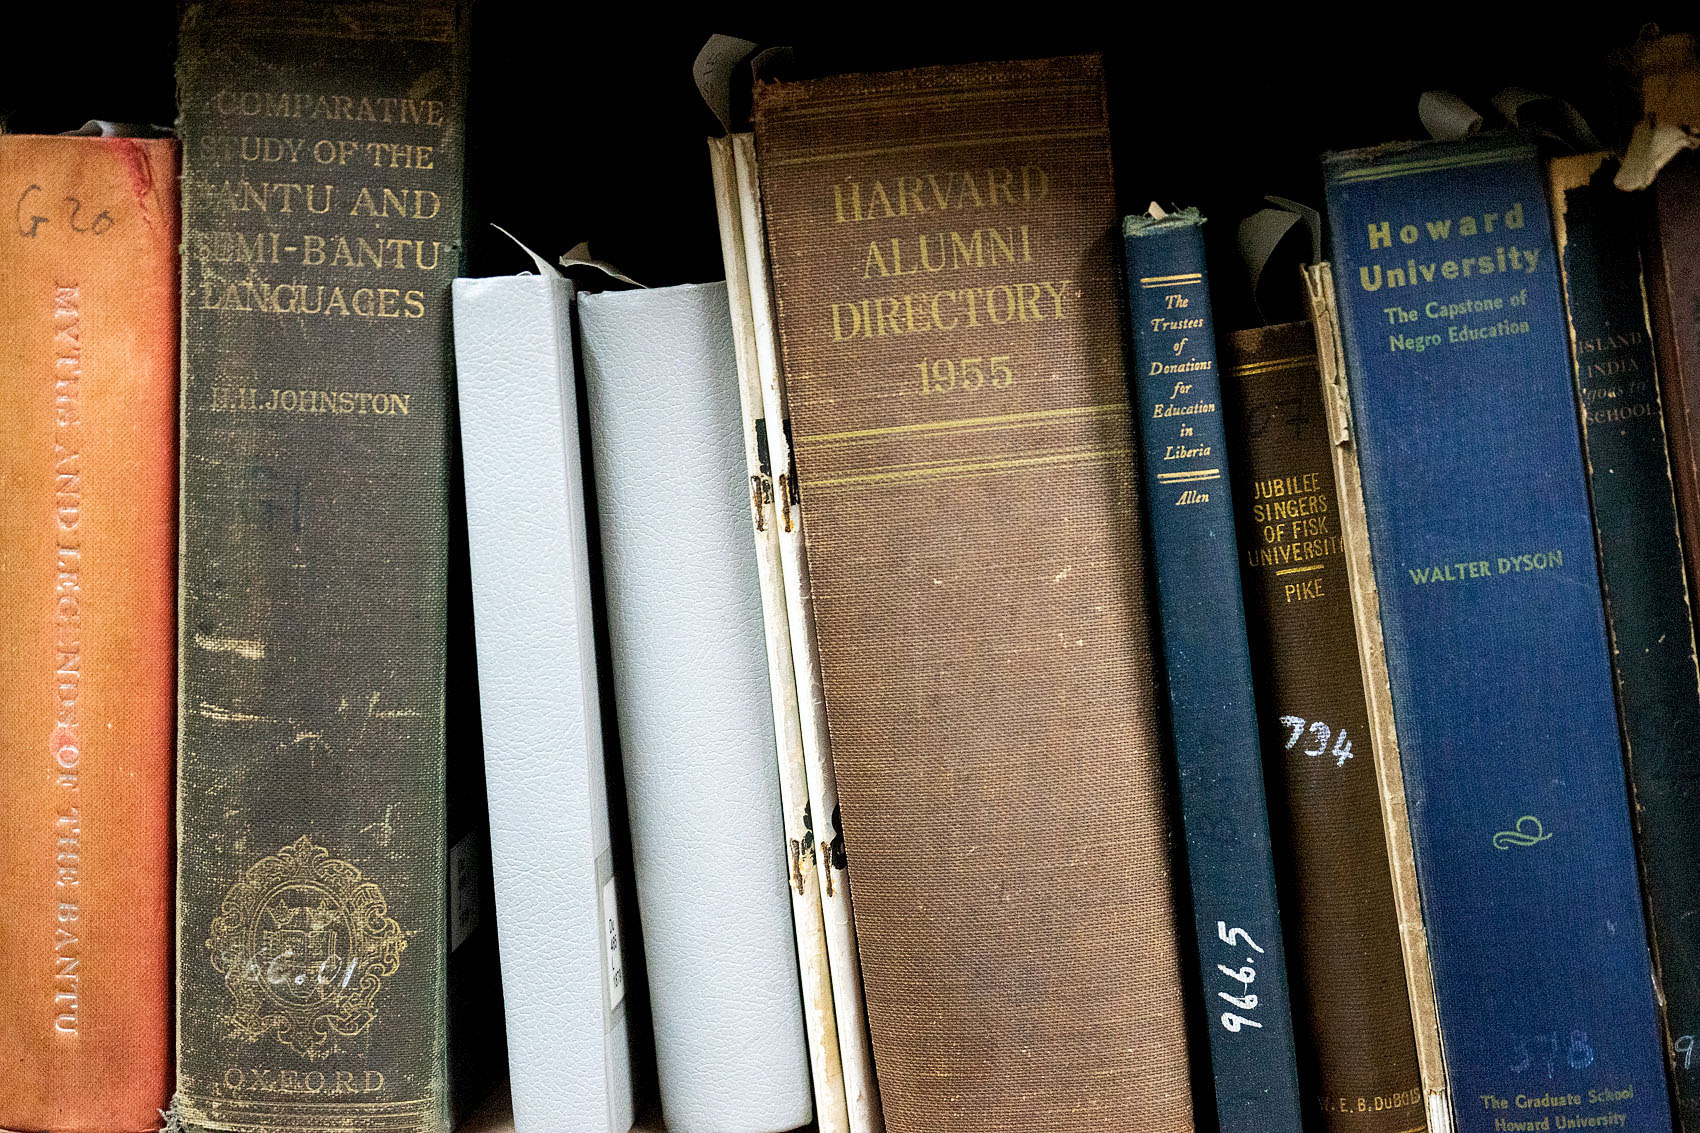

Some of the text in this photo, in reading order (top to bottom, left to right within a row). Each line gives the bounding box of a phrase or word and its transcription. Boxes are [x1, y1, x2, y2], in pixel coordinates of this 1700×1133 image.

[214, 90, 445, 127] COMPARATIVE
[202, 136, 434, 169] STUDY OF THE
[198, 178, 442, 220] ANTU AND
[832, 164, 1050, 224] HARVARD
[17, 184, 48, 238] G
[1366, 201, 1526, 251] Howard
[863, 225, 1032, 280] ALUMNI
[1359, 244, 1540, 293] University
[198, 280, 426, 319] LANGUAGES
[831, 279, 1073, 343] DIRECTORY
[1164, 294, 1190, 310] The
[1384, 287, 1528, 325] The Capstone of
[1150, 316, 1204, 333] Trustees
[1388, 318, 1530, 352] Negro Education
[1173, 338, 1189, 356] of
[915, 355, 1014, 397] 1955
[1149, 357, 1213, 376] Donations
[1170, 381, 1193, 400] for
[1152, 400, 1216, 419] Education
[1179, 422, 1194, 438] in
[1163, 443, 1212, 461] Liberia
[1175, 490, 1210, 506] Allen
[1254, 472, 1321, 500] JUBILEE
[1253, 494, 1328, 523] SINGERS
[1263, 515, 1329, 544] OF FISK
[1408, 549, 1563, 585] WALTER DYSON
[1284, 578, 1325, 603] PIKE
[54, 282, 82, 1036] MYTHS AND LEGENDS OF THE BANTU
[1216, 919, 1265, 1033] 966.5
[223, 1067, 385, 1095] OXFORD
[1480, 1083, 1634, 1110] The Graduate School
[1494, 1110, 1628, 1132] Howard University
